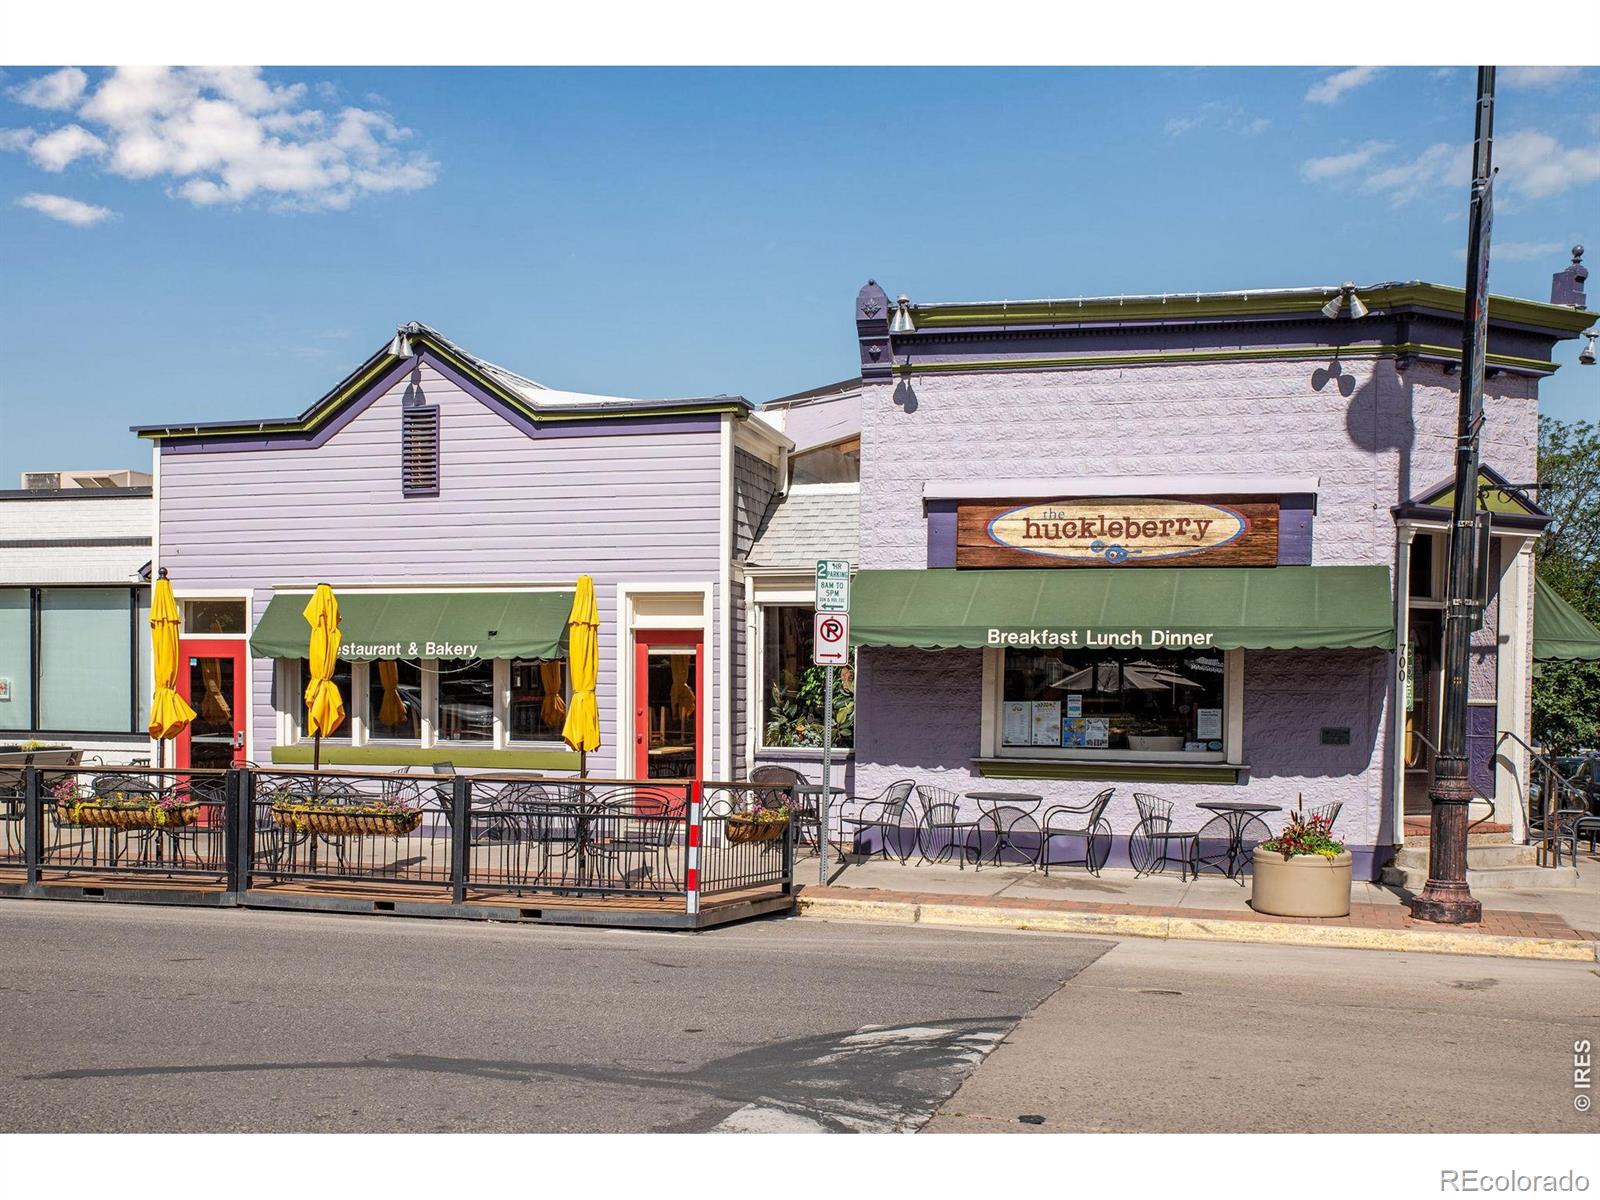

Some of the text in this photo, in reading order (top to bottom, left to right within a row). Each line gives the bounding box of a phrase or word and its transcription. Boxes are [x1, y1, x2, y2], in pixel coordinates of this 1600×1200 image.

[1042, 508, 1065, 520] the
[1022, 515, 1213, 541] huckleberry
[818, 563, 826, 577] 2
[821, 581, 834, 589] 8AM
[986, 629, 1214, 645] Breakfast Lunch Dinner
[336, 641, 479, 657] estaurant & Bakery
